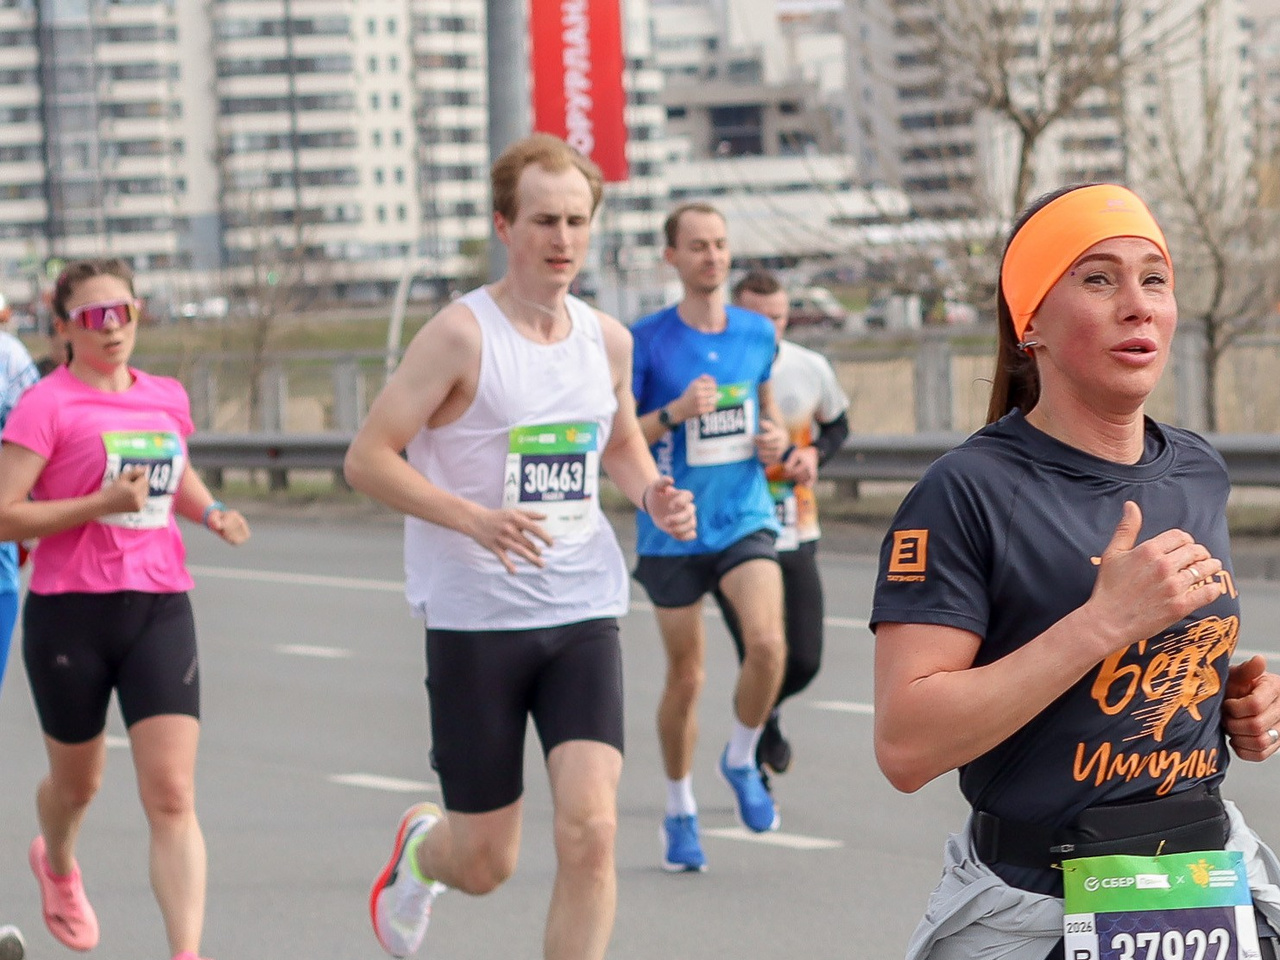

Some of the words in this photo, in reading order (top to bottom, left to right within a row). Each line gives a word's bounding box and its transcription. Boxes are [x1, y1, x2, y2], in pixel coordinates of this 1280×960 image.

[524, 461, 584, 494] 30463
[1101, 876, 1135, 889] СБЕР
[1066, 921, 1093, 934] 2026
